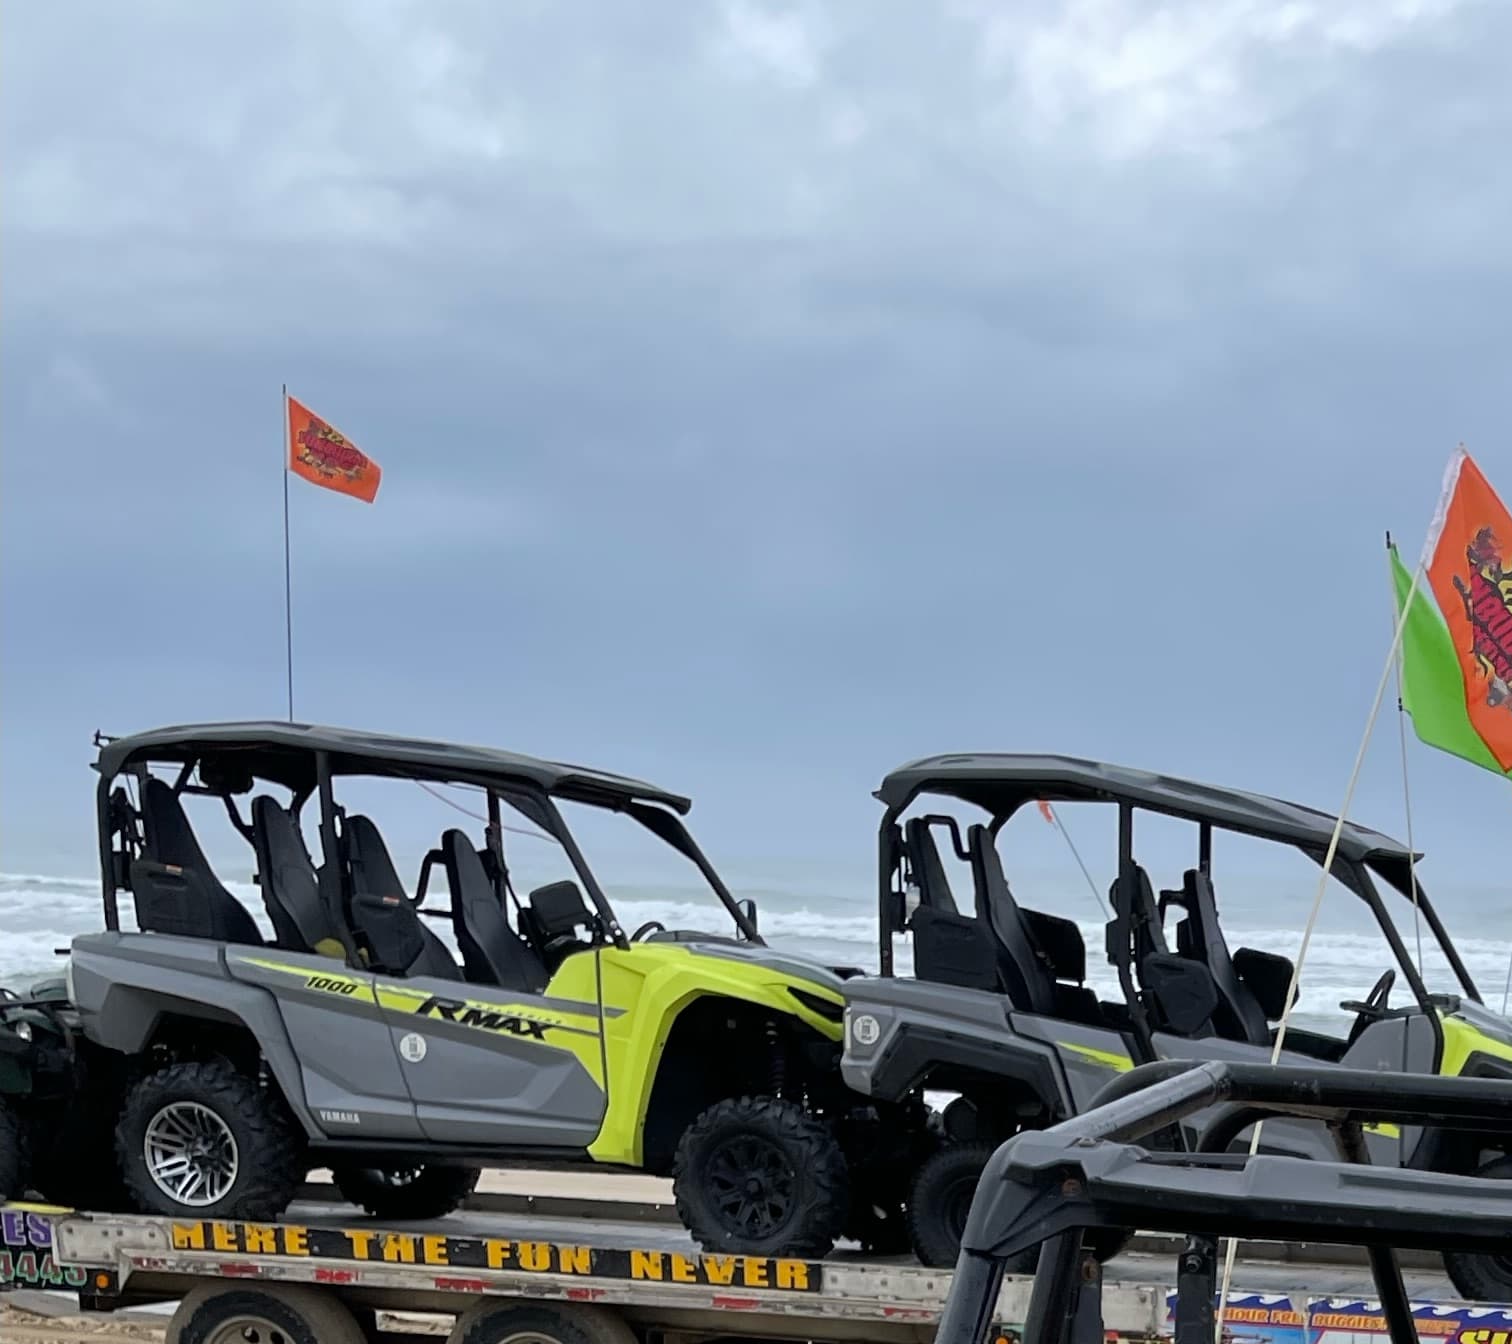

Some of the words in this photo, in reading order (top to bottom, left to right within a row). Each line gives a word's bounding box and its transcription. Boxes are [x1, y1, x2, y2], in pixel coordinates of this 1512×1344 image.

[305, 975, 357, 995] 1000
[414, 995, 552, 1041] RMAX
[319, 1110, 361, 1124] YAMAHA
[344, 1228, 450, 1266] THE
[486, 1239, 592, 1275] FUN
[629, 1250, 809, 1290] NEVER
